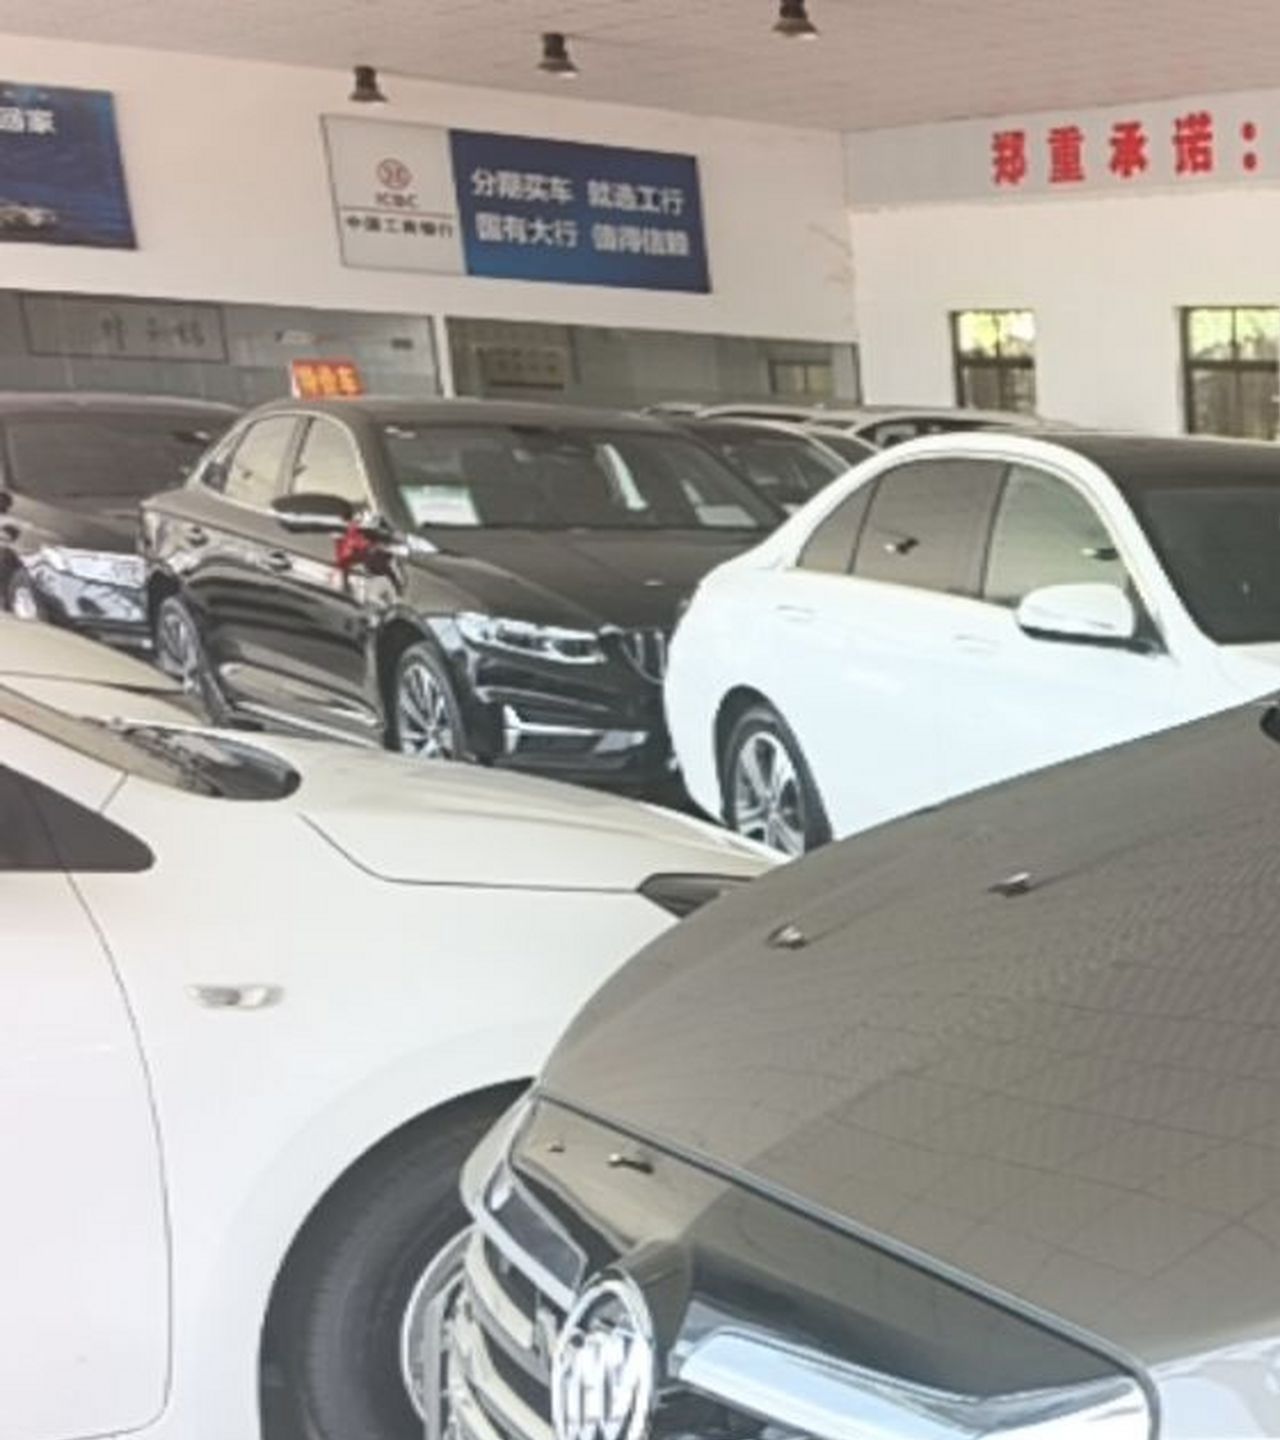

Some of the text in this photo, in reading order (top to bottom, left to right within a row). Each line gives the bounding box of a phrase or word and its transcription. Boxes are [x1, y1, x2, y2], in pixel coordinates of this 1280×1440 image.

[471, 167, 573, 205] 分期买车
[474, 211, 578, 248] 国有大行
